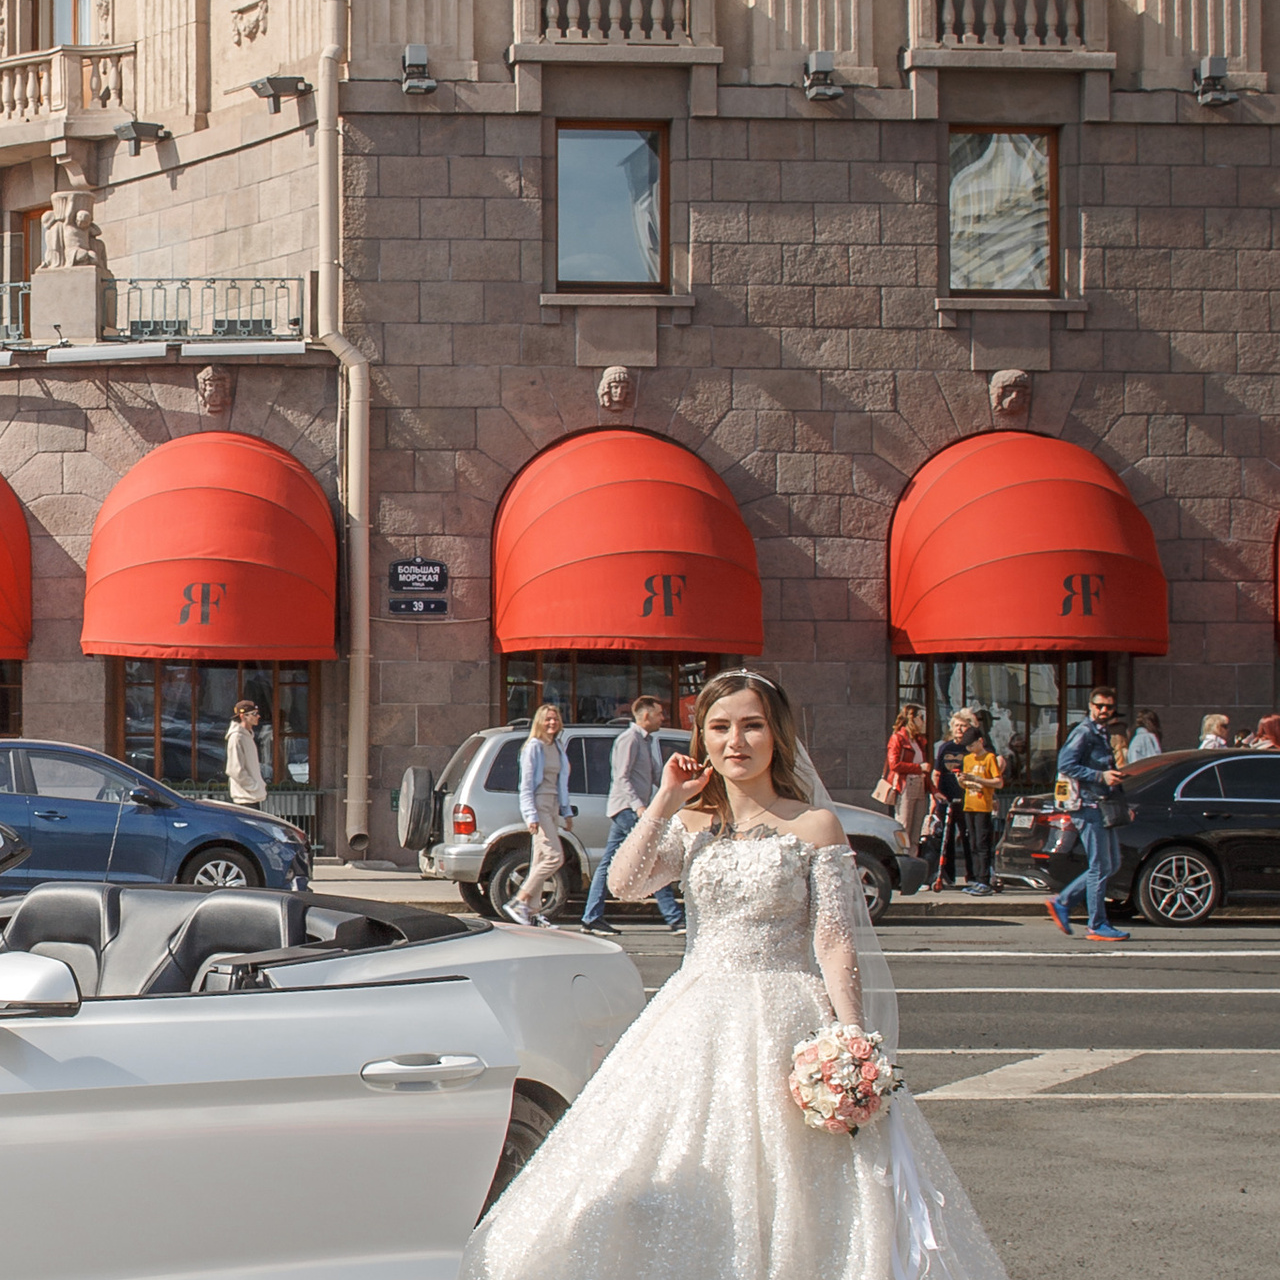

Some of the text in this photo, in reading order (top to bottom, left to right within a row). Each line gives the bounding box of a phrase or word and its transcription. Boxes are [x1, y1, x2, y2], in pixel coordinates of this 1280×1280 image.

[397, 565, 440, 574] БОЛЬШАЯ
[398, 574, 439, 582] МОРСКАЯ
[412, 601, 424, 611] 39
